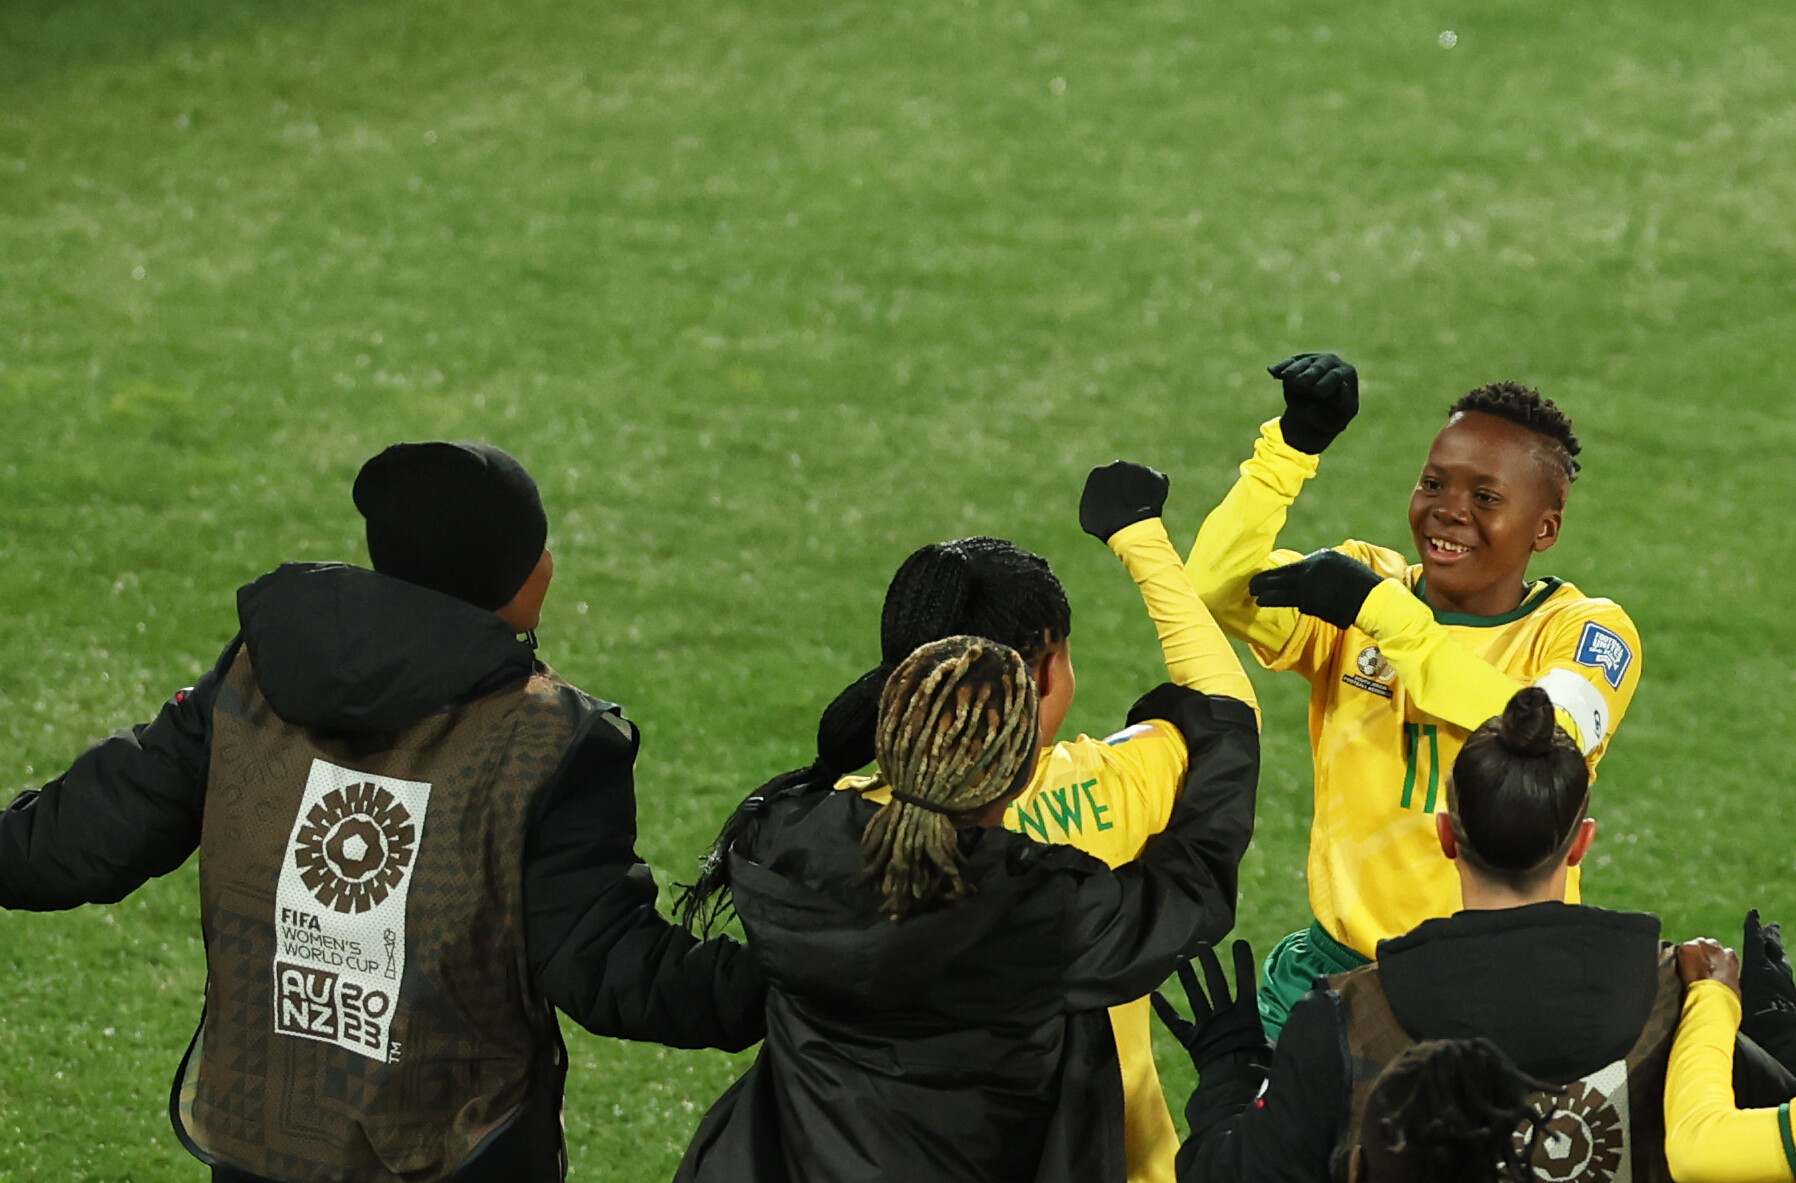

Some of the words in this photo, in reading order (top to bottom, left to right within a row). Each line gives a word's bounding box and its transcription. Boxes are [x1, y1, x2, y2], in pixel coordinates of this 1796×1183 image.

[1401, 723, 1439, 814] 11
[1002, 779, 1114, 842] NWE
[281, 908, 321, 932] FIFA
[281, 925, 362, 956] WOMEN'S
[283, 942, 343, 967] WORLD
[346, 949, 380, 975] CUP
[282, 969, 333, 1005] AU
[341, 982, 390, 1019] 20
[282, 998, 334, 1035] NZ
[343, 1011, 381, 1050] 23
